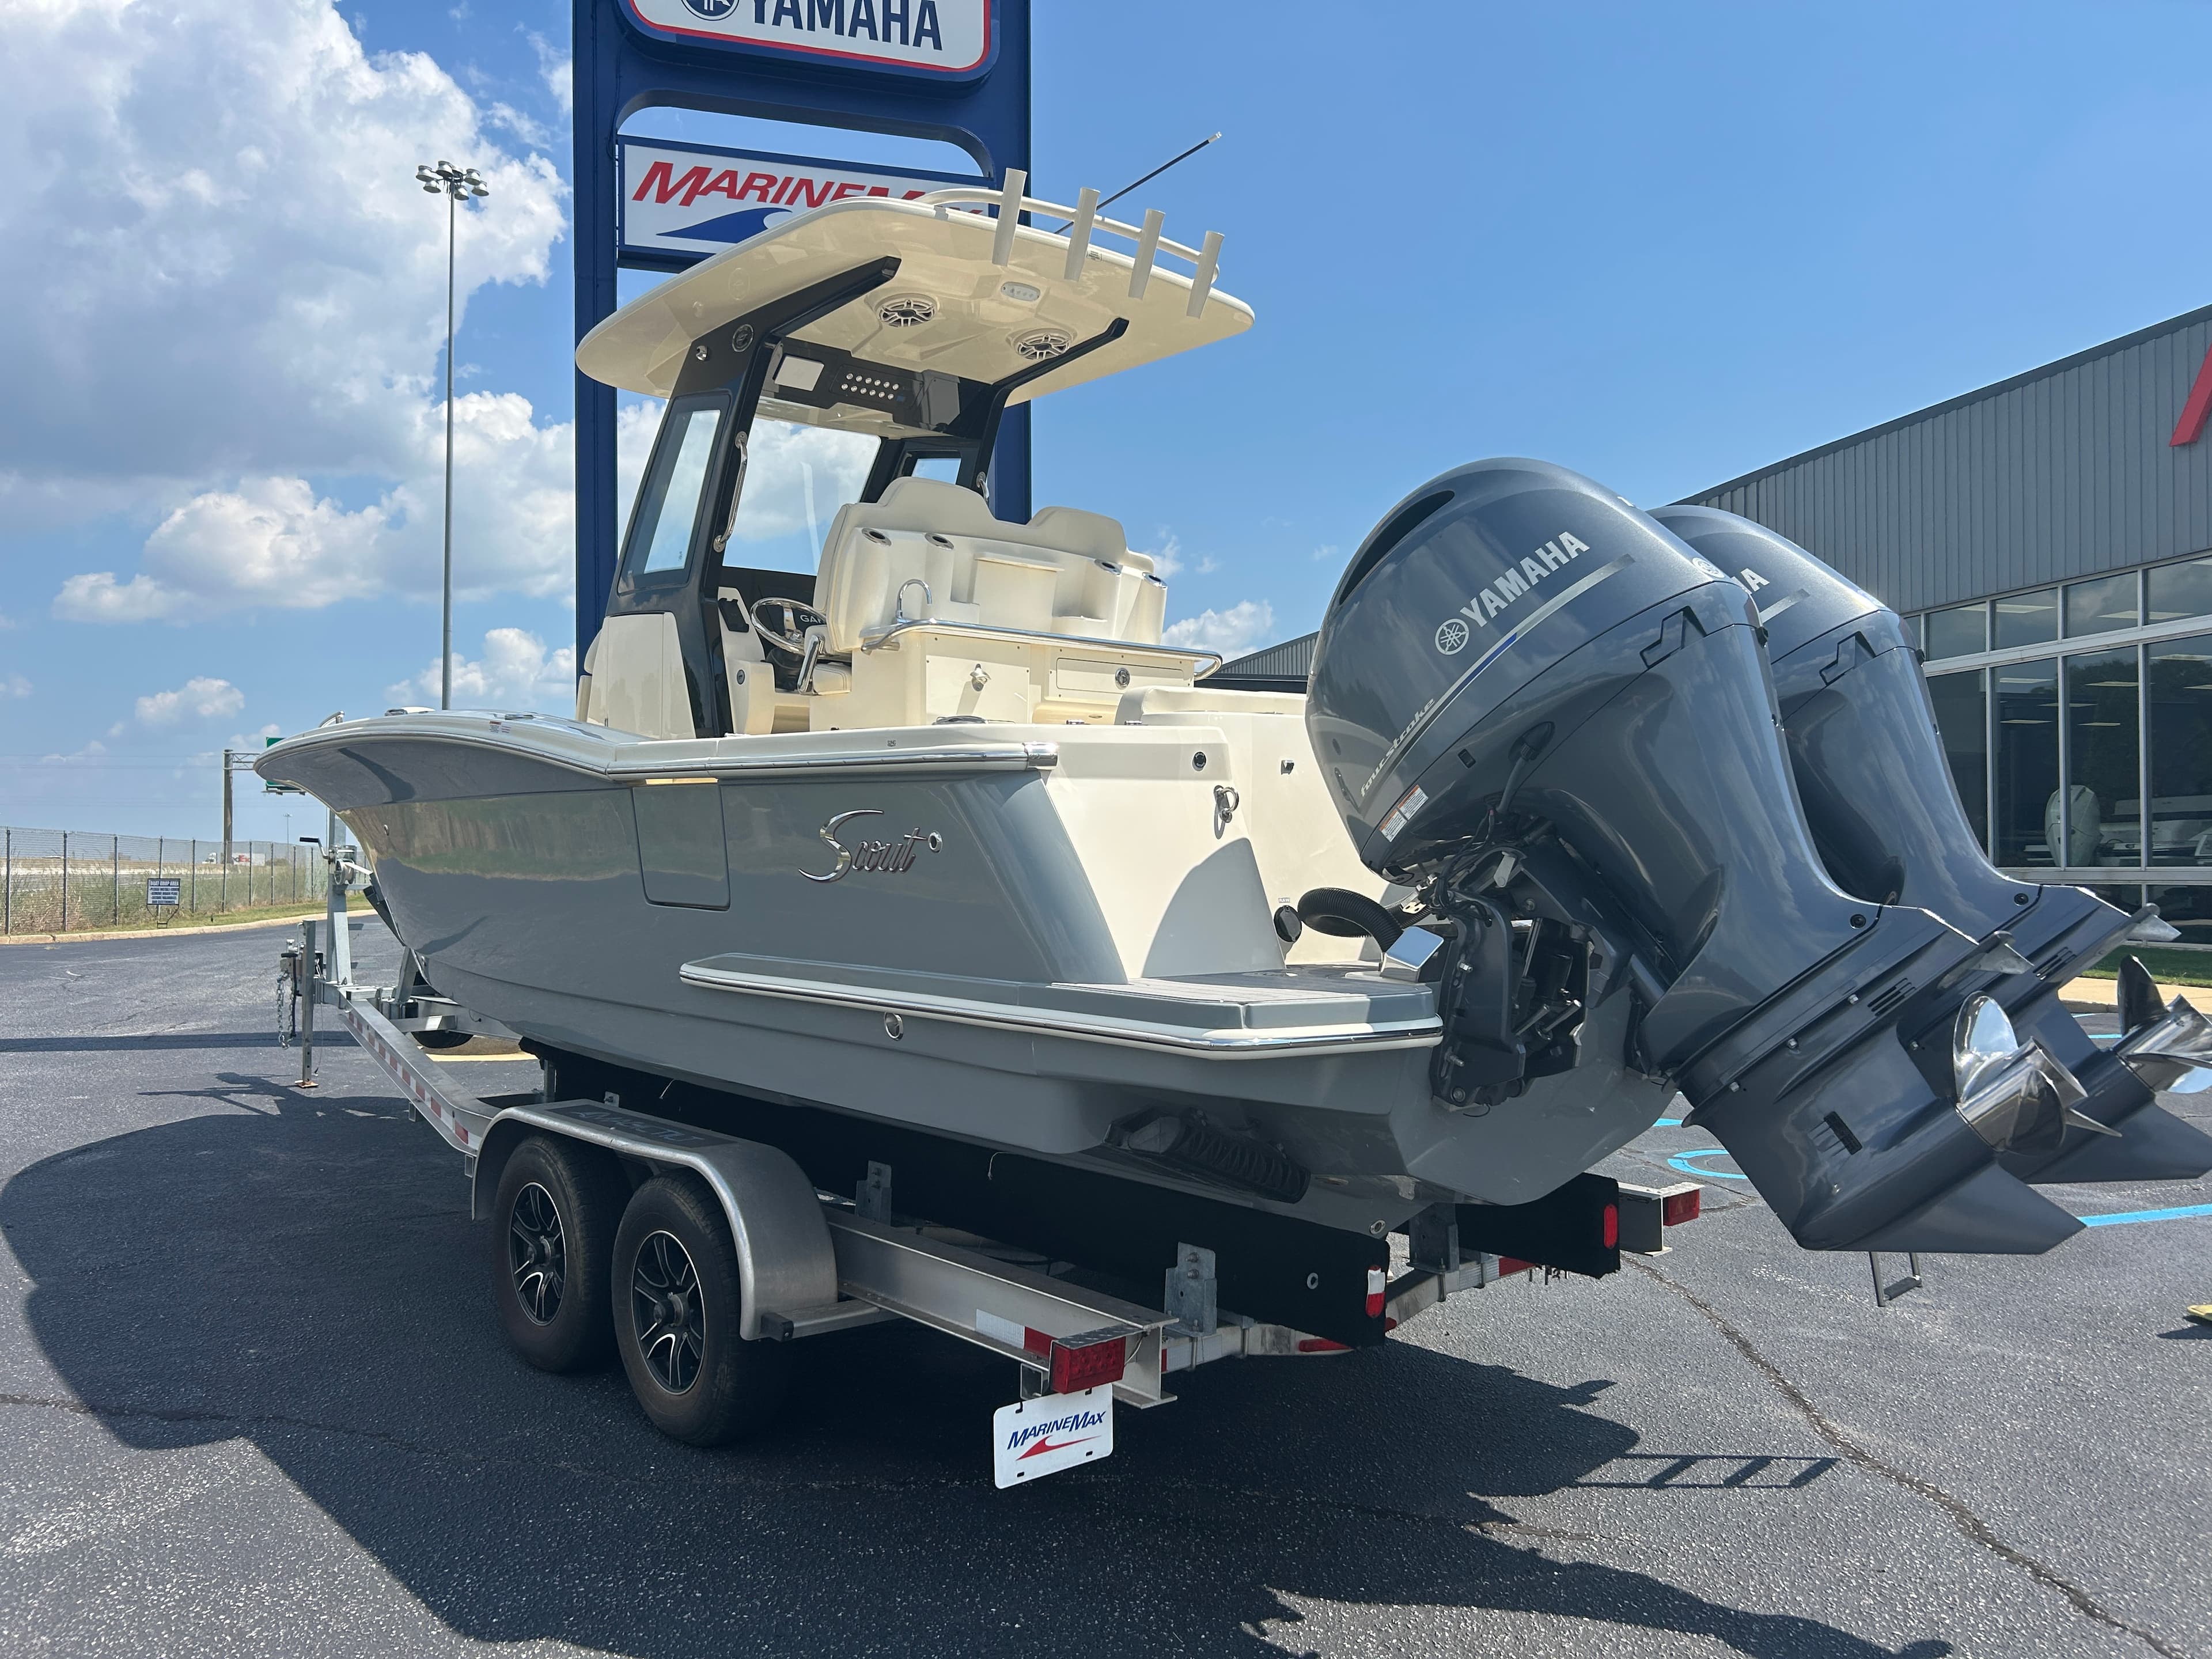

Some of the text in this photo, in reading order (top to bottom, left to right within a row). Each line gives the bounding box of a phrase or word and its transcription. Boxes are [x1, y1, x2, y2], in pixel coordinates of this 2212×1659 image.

[632, 161, 983, 215] MARINE
[1460, 531, 1590, 627] YAMAHA
[798, 809, 927, 882] Scout
